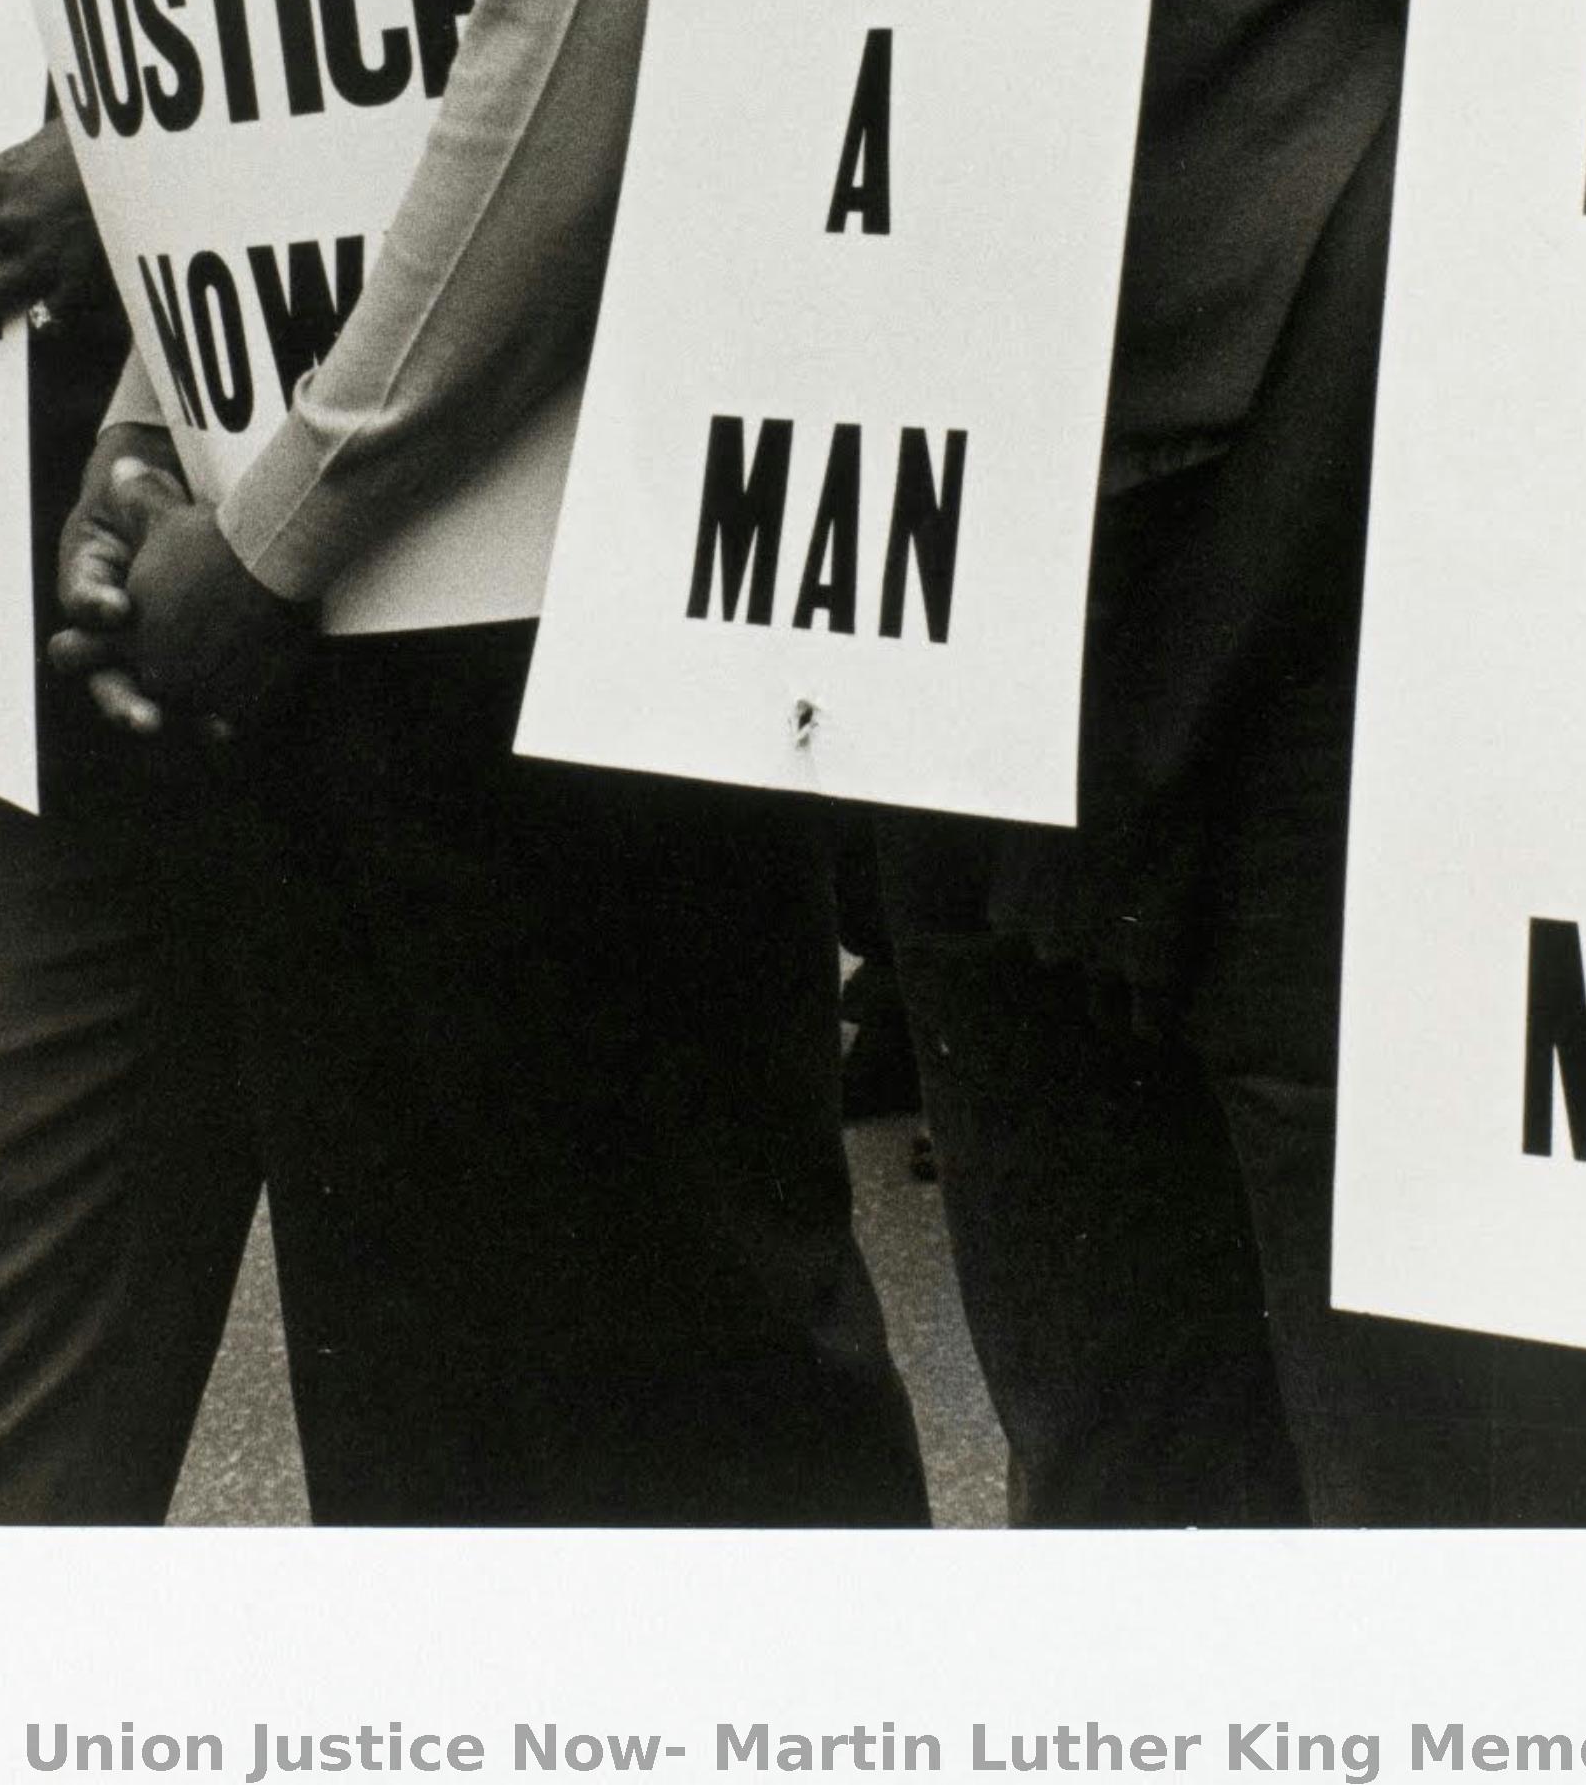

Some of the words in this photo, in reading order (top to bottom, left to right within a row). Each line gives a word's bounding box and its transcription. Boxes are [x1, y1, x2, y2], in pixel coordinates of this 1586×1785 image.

[825, 28, 893, 236] A
[138, 235, 364, 433] NOW
[686, 415, 968, 644] MAN
